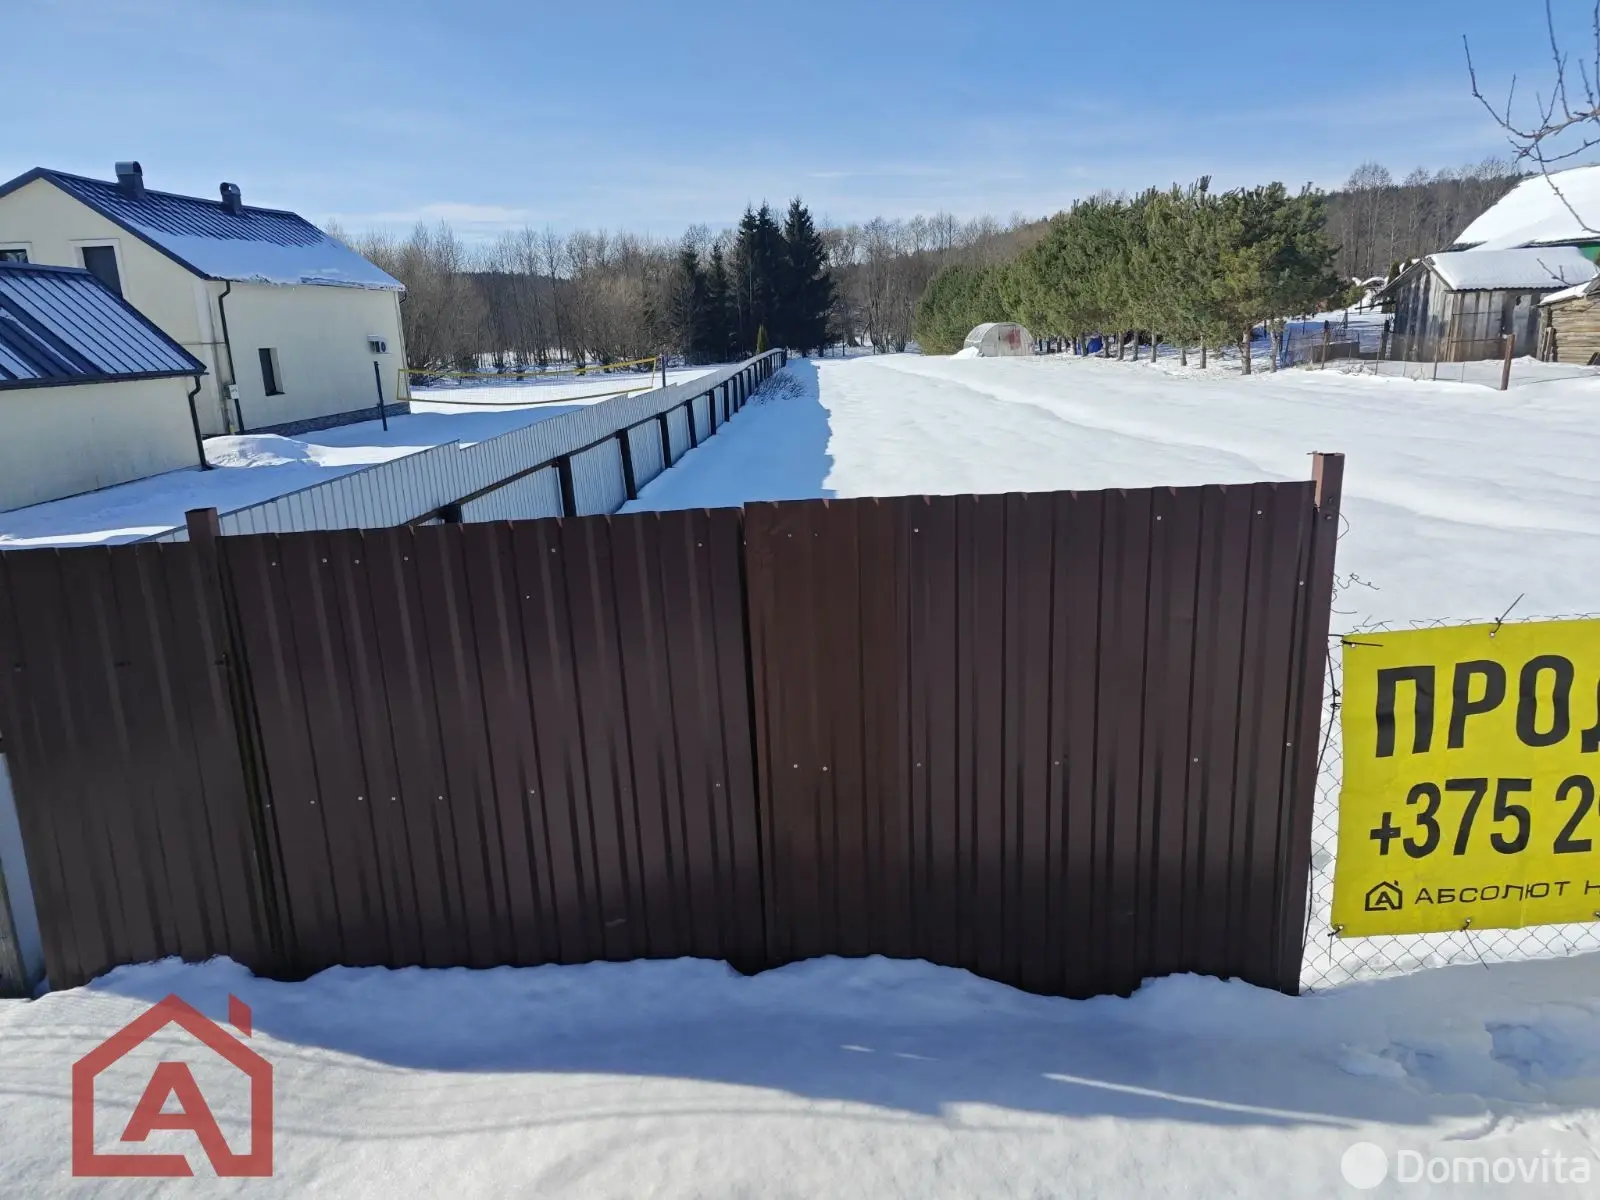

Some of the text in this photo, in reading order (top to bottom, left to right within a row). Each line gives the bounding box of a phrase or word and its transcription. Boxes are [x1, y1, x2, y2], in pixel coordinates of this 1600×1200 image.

[1370, 774, 1600, 858] +375 2
[1415, 881, 1570, 905] АБСОЛЮТ
